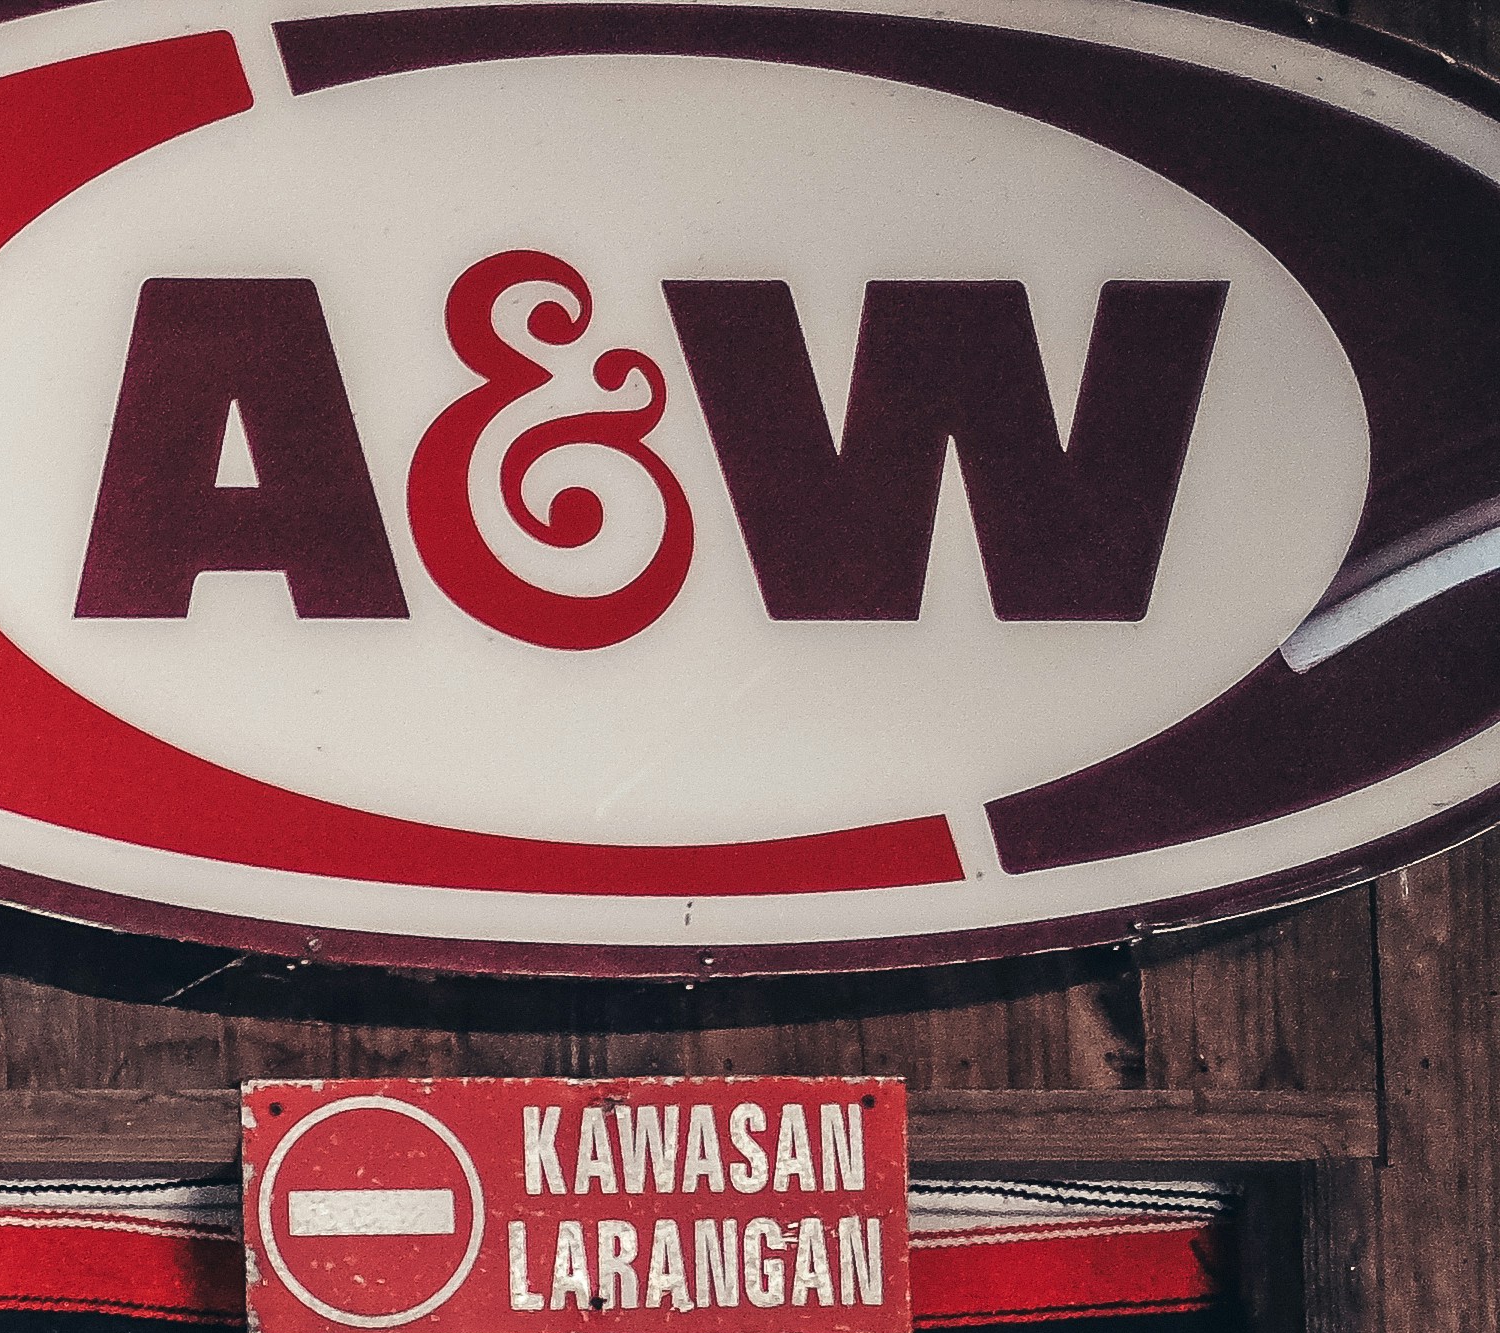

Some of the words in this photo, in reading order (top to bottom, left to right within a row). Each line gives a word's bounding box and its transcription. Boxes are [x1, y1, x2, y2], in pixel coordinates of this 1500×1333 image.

[74, 247, 1229, 650] A&W
[523, 1102, 866, 1195] KAWASAN
[508, 1216, 884, 1312] LARANGAN
